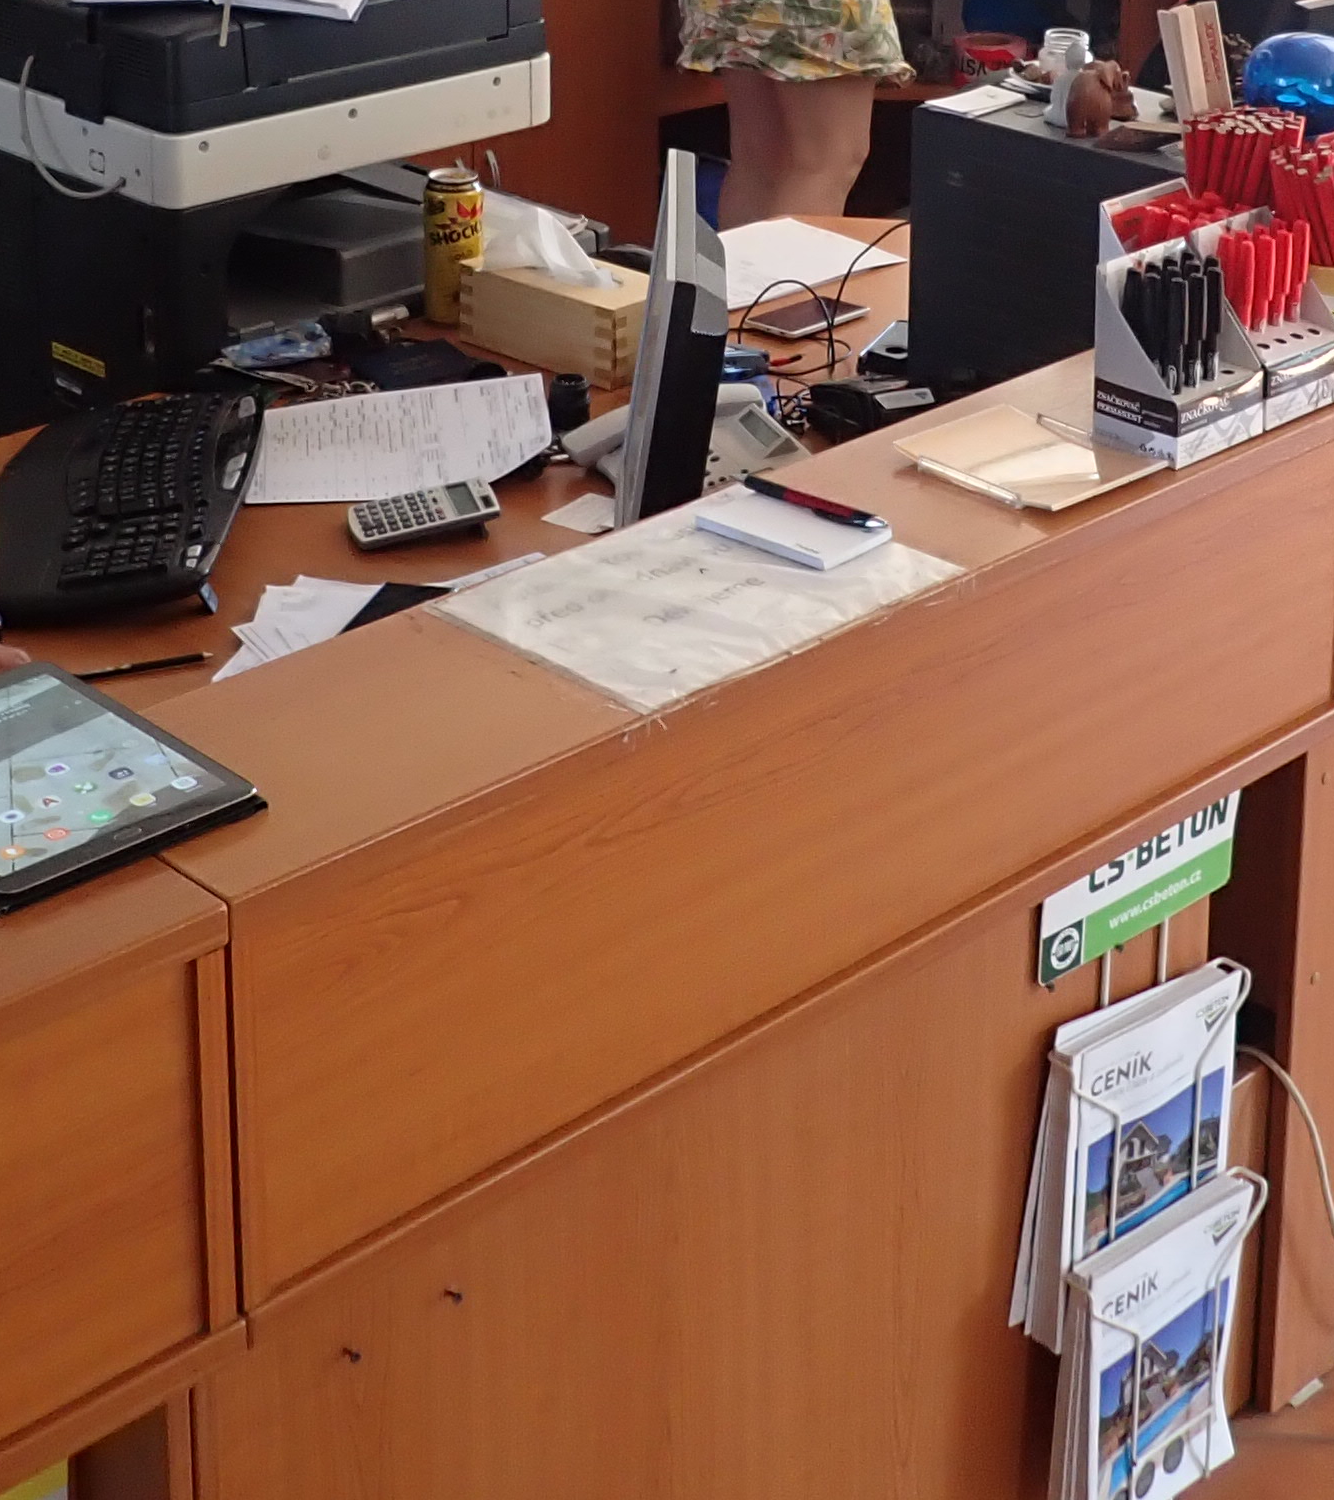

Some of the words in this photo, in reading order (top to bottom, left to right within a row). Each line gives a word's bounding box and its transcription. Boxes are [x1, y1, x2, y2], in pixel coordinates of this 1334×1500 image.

[1096, 389, 1141, 413] ZNAČKOVAČ
[1109, 869, 1203, 929] www.csbeton.cz
[1091, 1051, 1154, 1097] CENÍK
[1101, 1270, 1159, 1319] CENÍK
